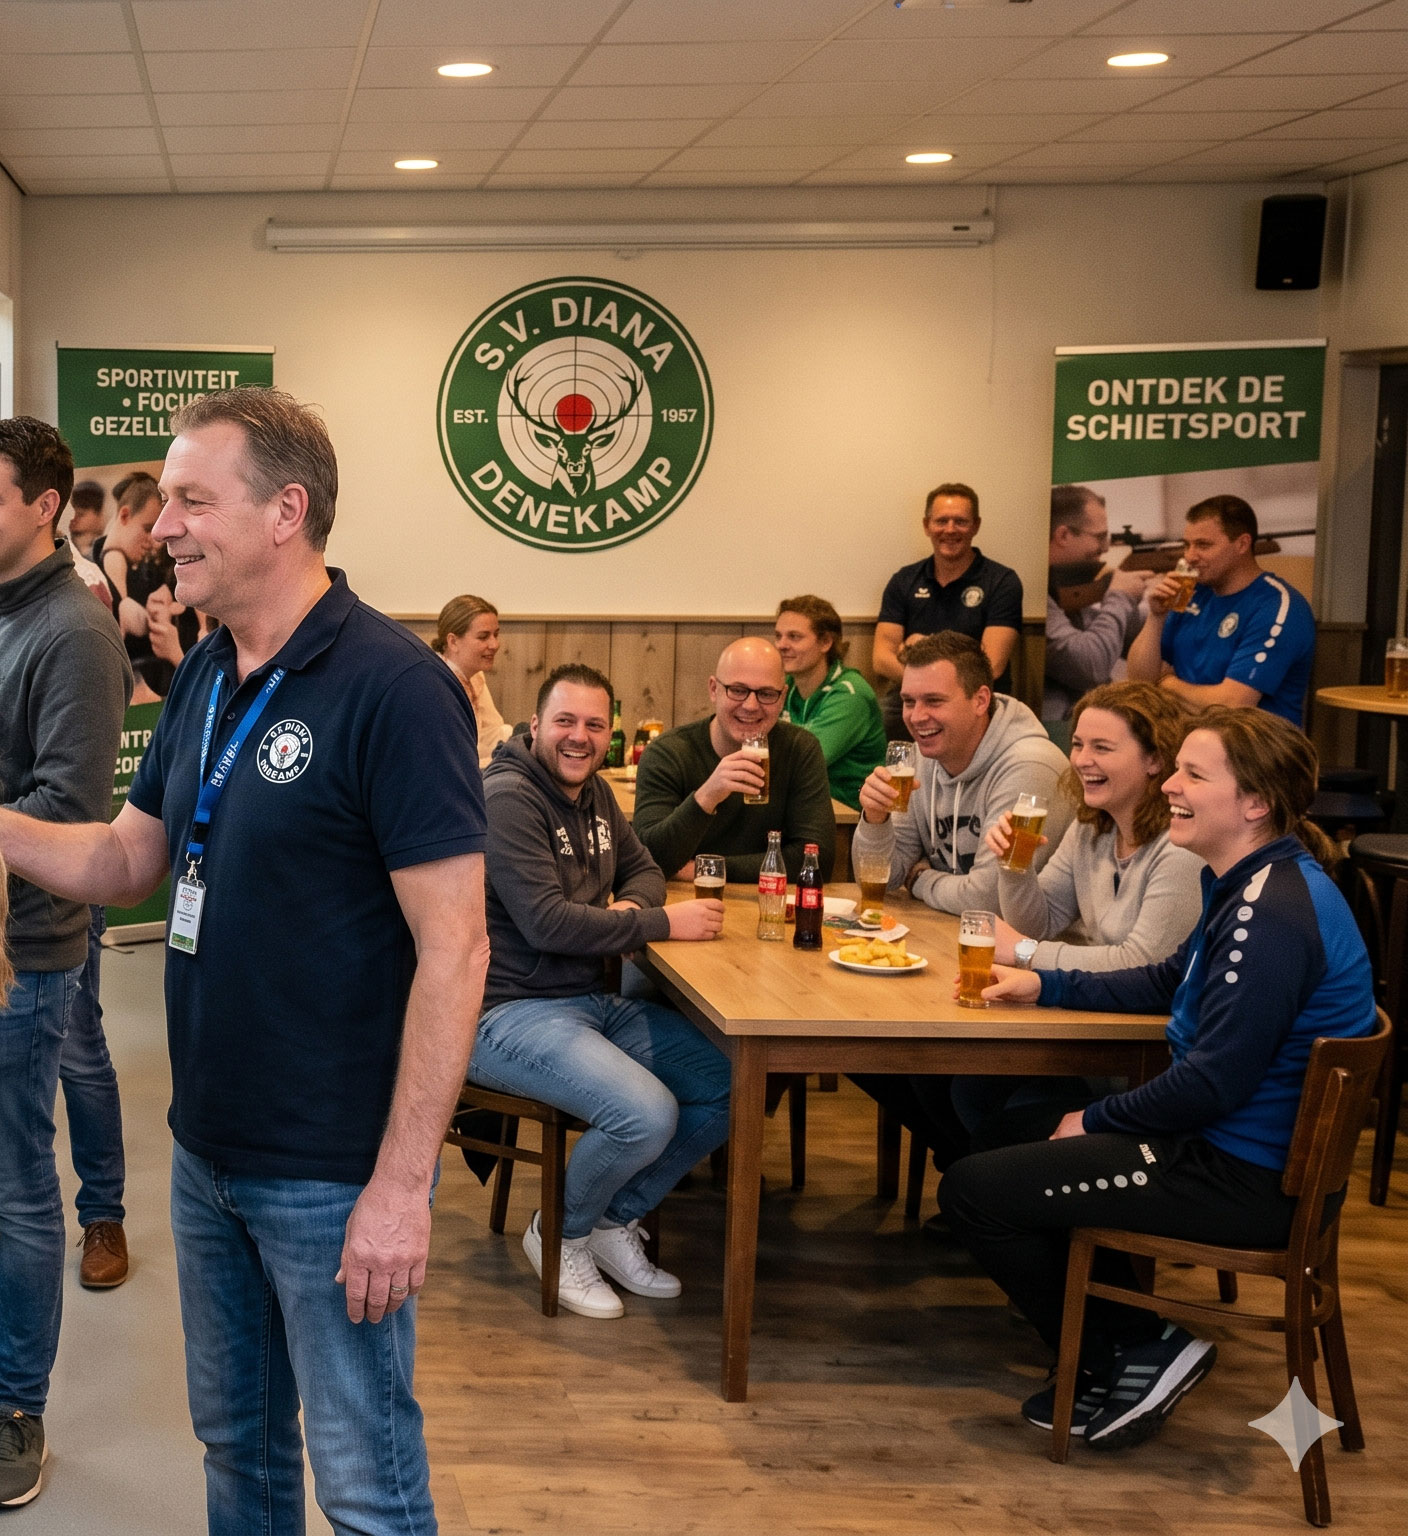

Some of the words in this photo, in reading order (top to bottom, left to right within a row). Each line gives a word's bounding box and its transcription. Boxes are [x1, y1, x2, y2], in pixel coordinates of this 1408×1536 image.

[474, 310, 541, 371] S.V.
[551, 296, 675, 373] DIANA
[97, 367, 239, 390] SPORTIVITEIT
[1088, 377, 1228, 406] ONTDEK
[1237, 375, 1284, 403] DE
[90, 416, 177, 437] GEZELL
[454, 409, 488, 424] EST.
[661, 409, 698, 422] 1957
[1067, 410, 1307, 440] SCHIETSPORT
[470, 456, 675, 534] DENEKAMP
